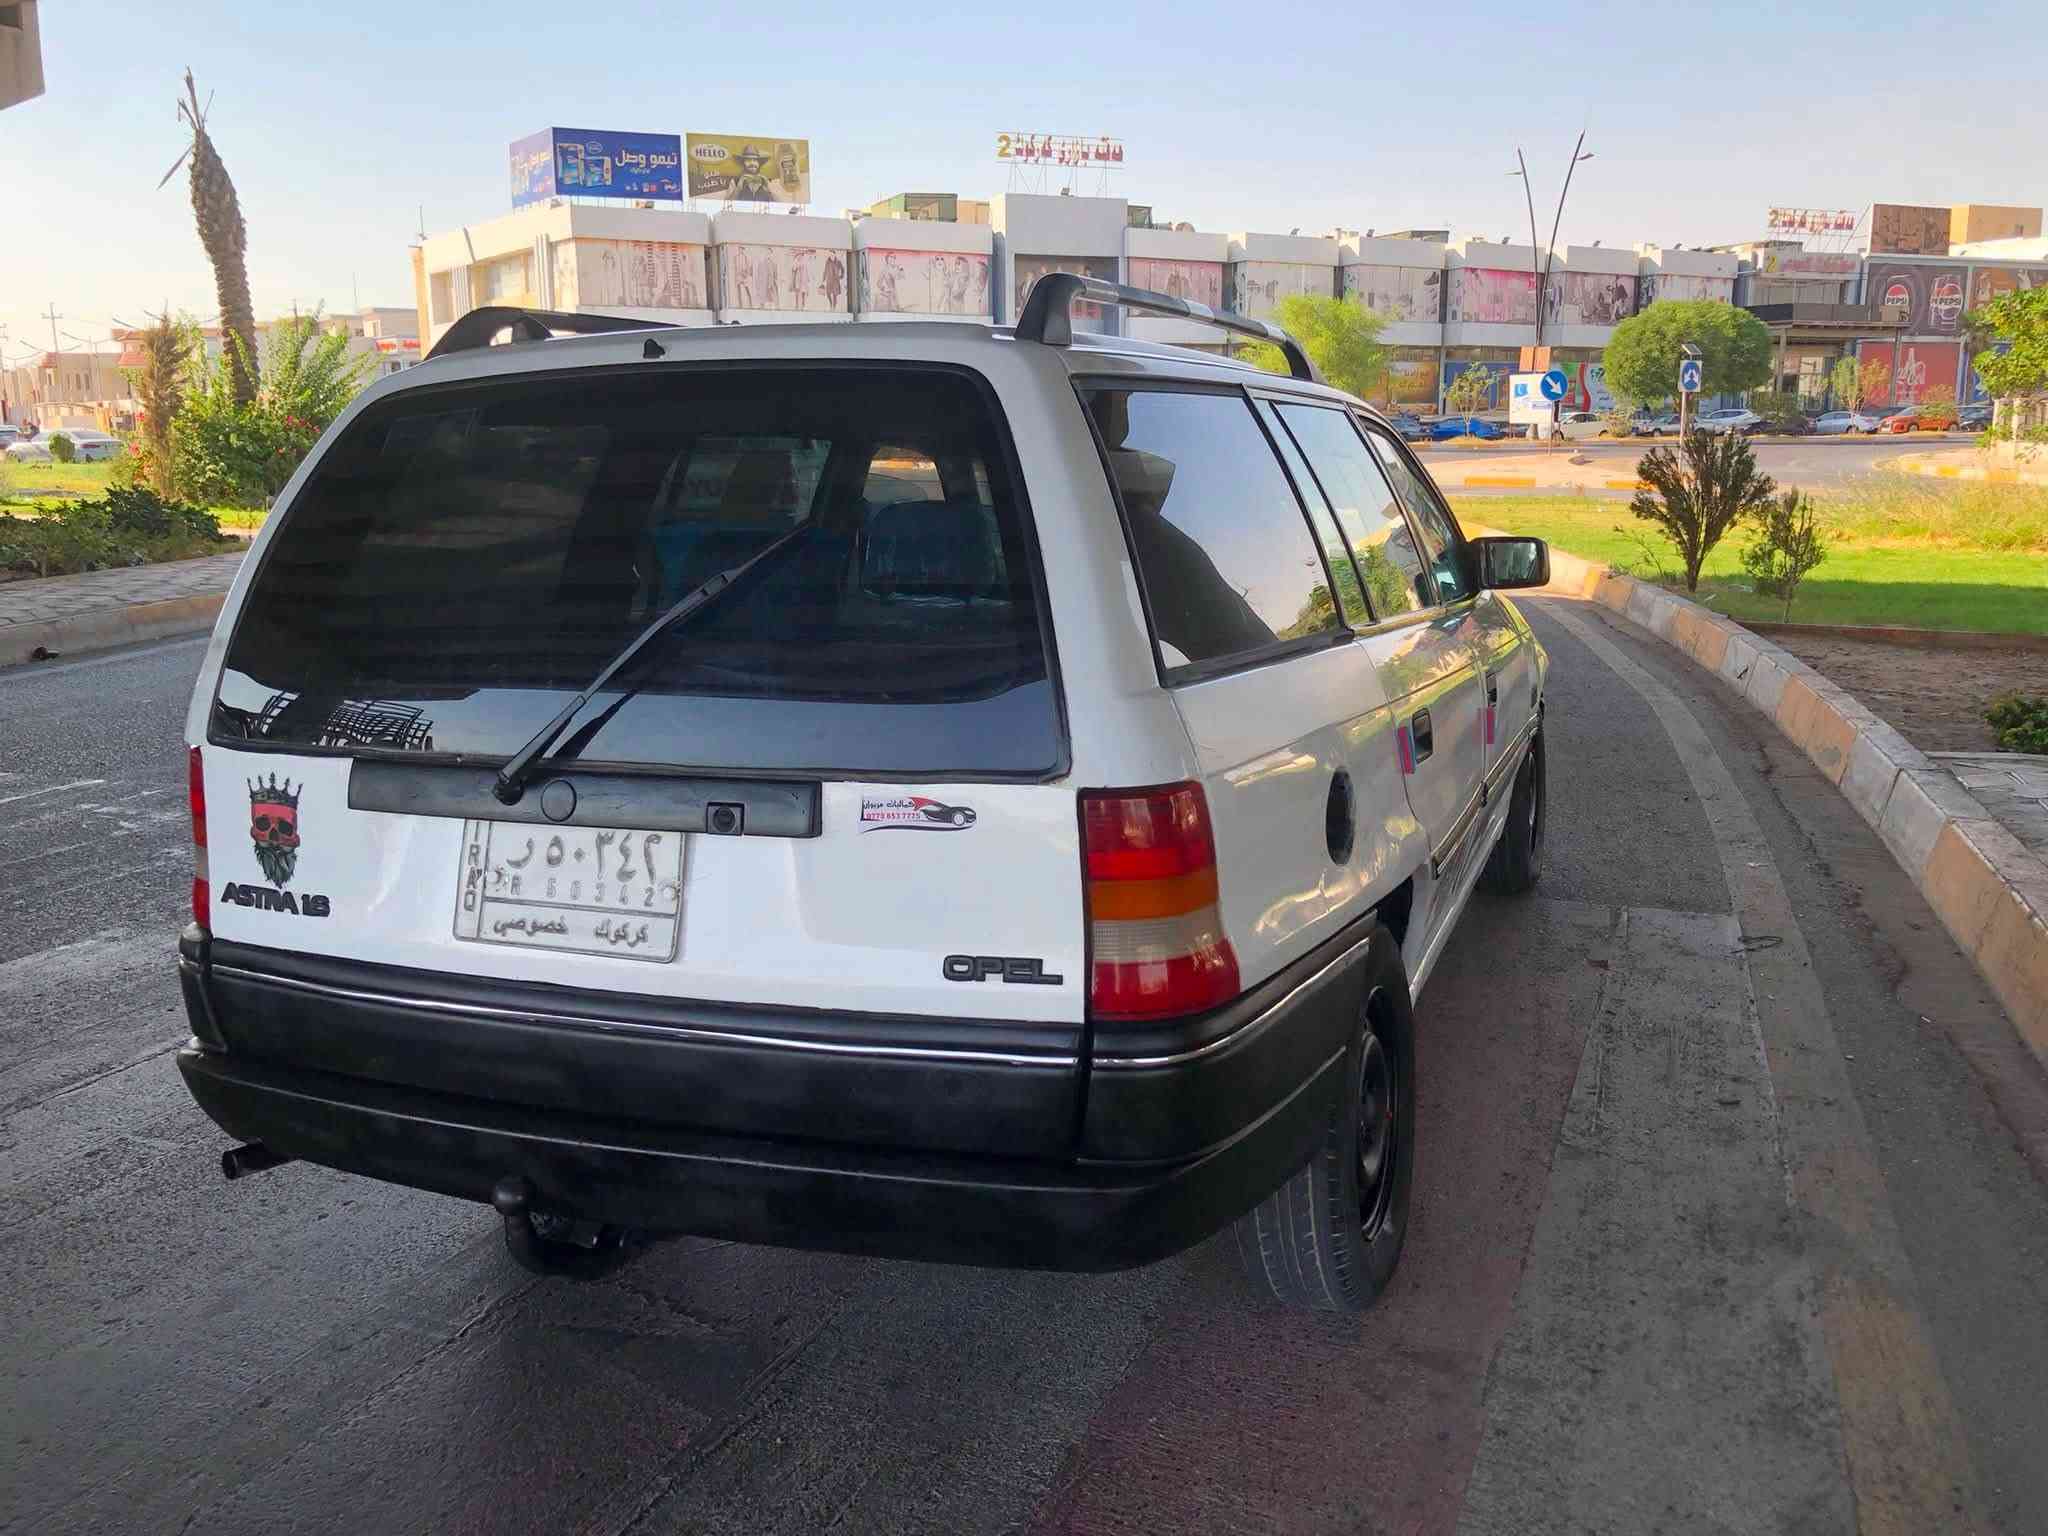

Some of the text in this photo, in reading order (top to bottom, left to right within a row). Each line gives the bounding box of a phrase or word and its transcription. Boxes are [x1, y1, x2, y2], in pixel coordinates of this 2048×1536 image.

[695, 148, 726, 158] HELLO
[220, 881, 300, 915] ASTRA
[493, 914, 649, 948] كركوك خصوصي
[943, 955, 1063, 985] OPEL
